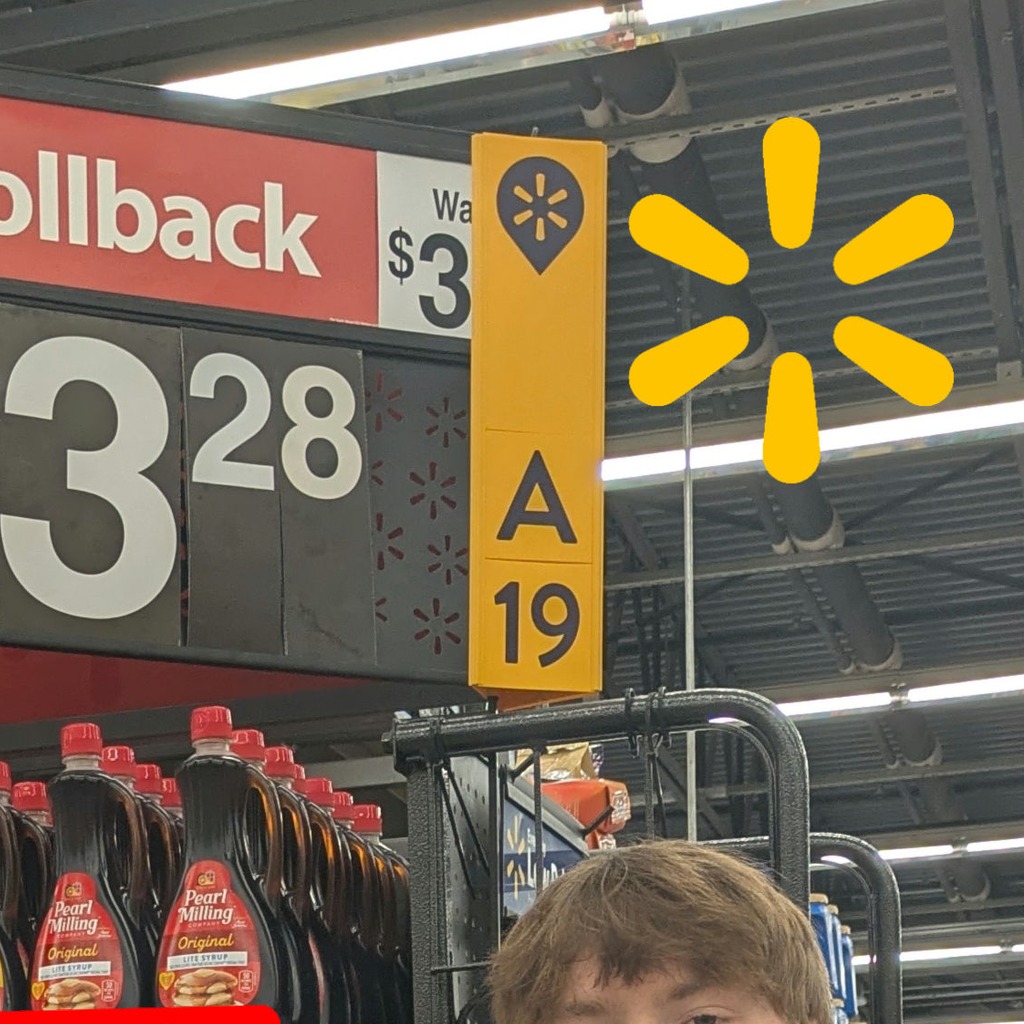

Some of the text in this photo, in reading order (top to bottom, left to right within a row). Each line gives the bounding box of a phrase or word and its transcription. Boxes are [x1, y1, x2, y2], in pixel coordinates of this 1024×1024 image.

[432, 188, 473, 225] Wa
[495, 449, 579, 546] A
[494, 581, 581, 668] 19
[185, 890, 227, 905] Pearl
[55, 901, 92, 916] Pearl
[178, 906, 234, 924] Milling
[49, 916, 98, 934] Milling
[178, 933, 234, 950] Original
[48, 944, 97, 960] Original
